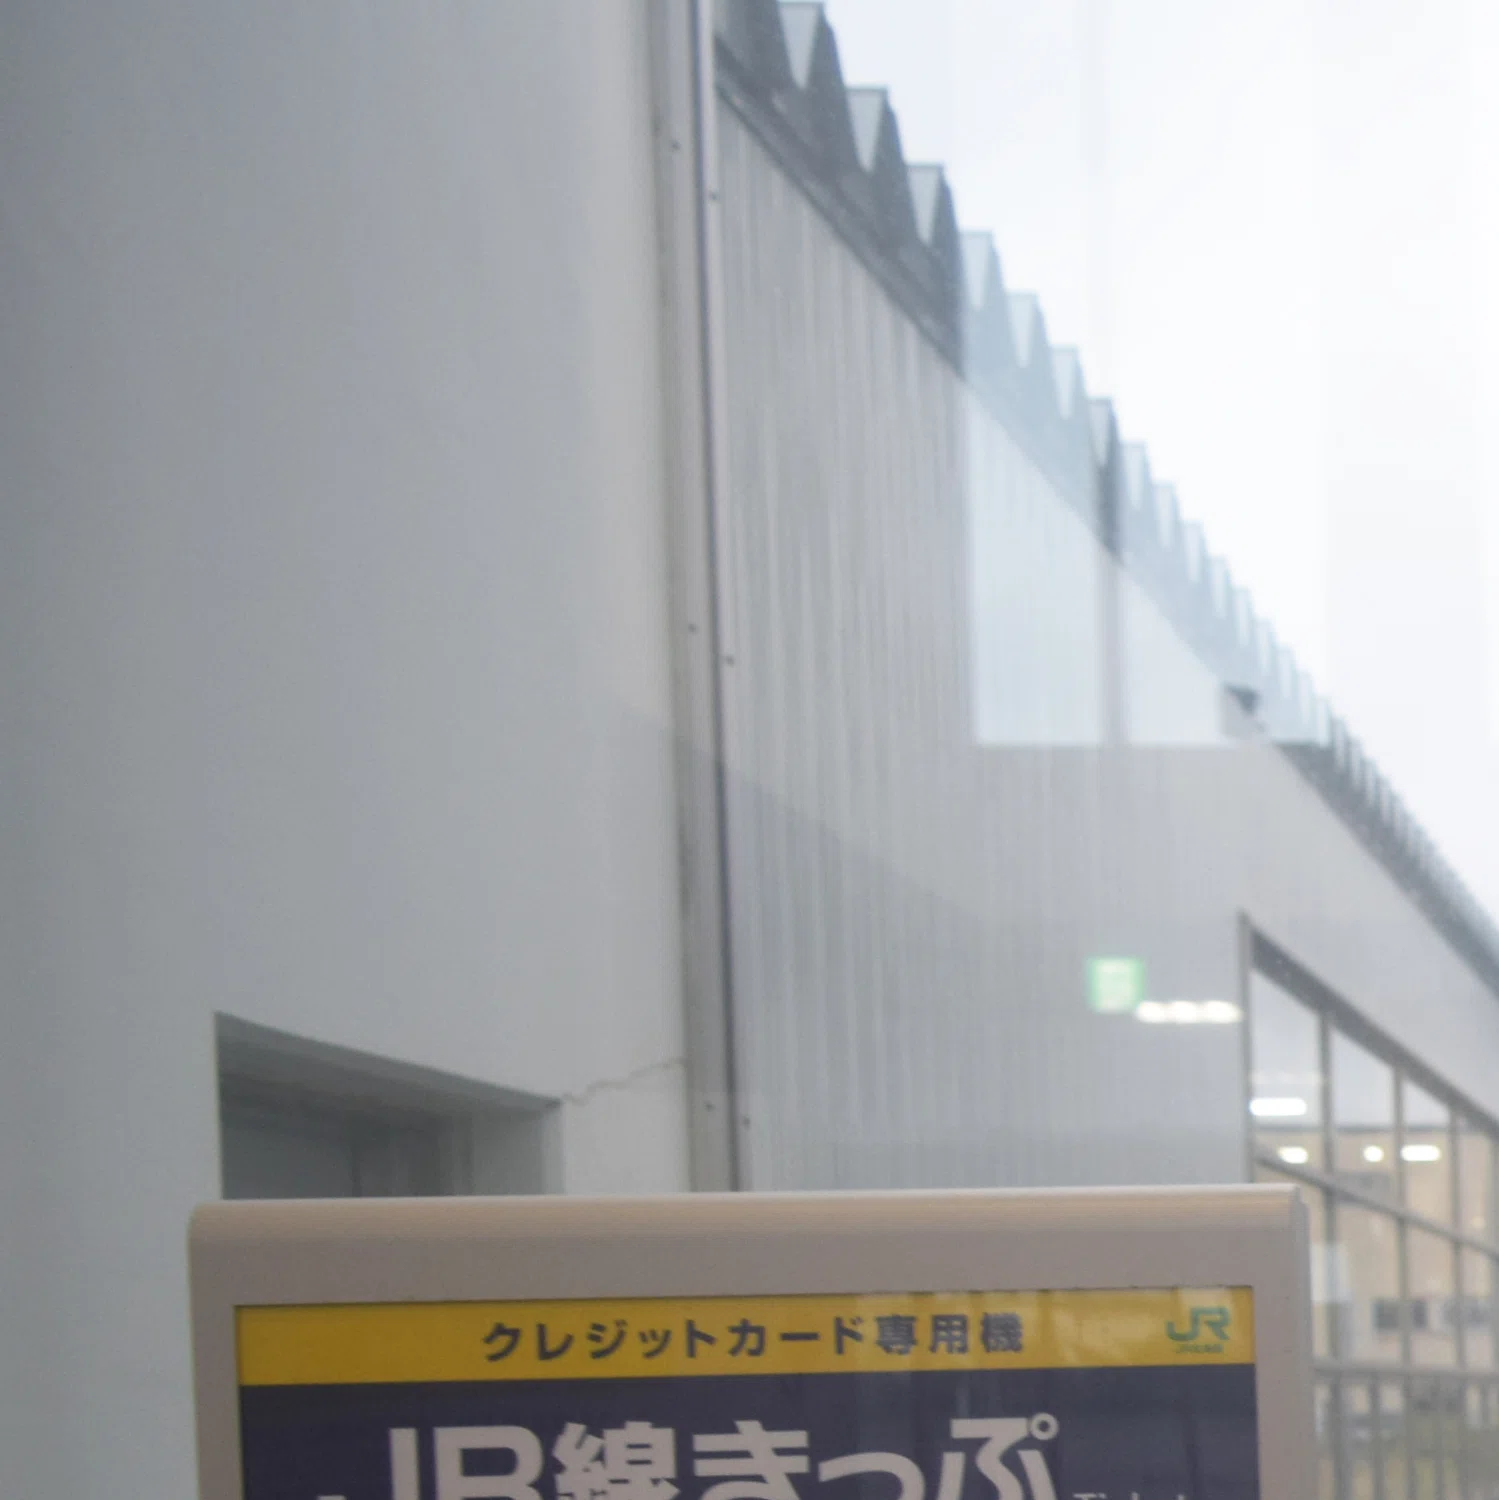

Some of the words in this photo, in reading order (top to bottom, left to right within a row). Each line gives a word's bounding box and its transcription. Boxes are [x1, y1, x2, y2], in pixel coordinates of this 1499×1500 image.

[482, 1310, 1025, 1361] クレジットカード専用機
[1165, 1306, 1230, 1341] JR
